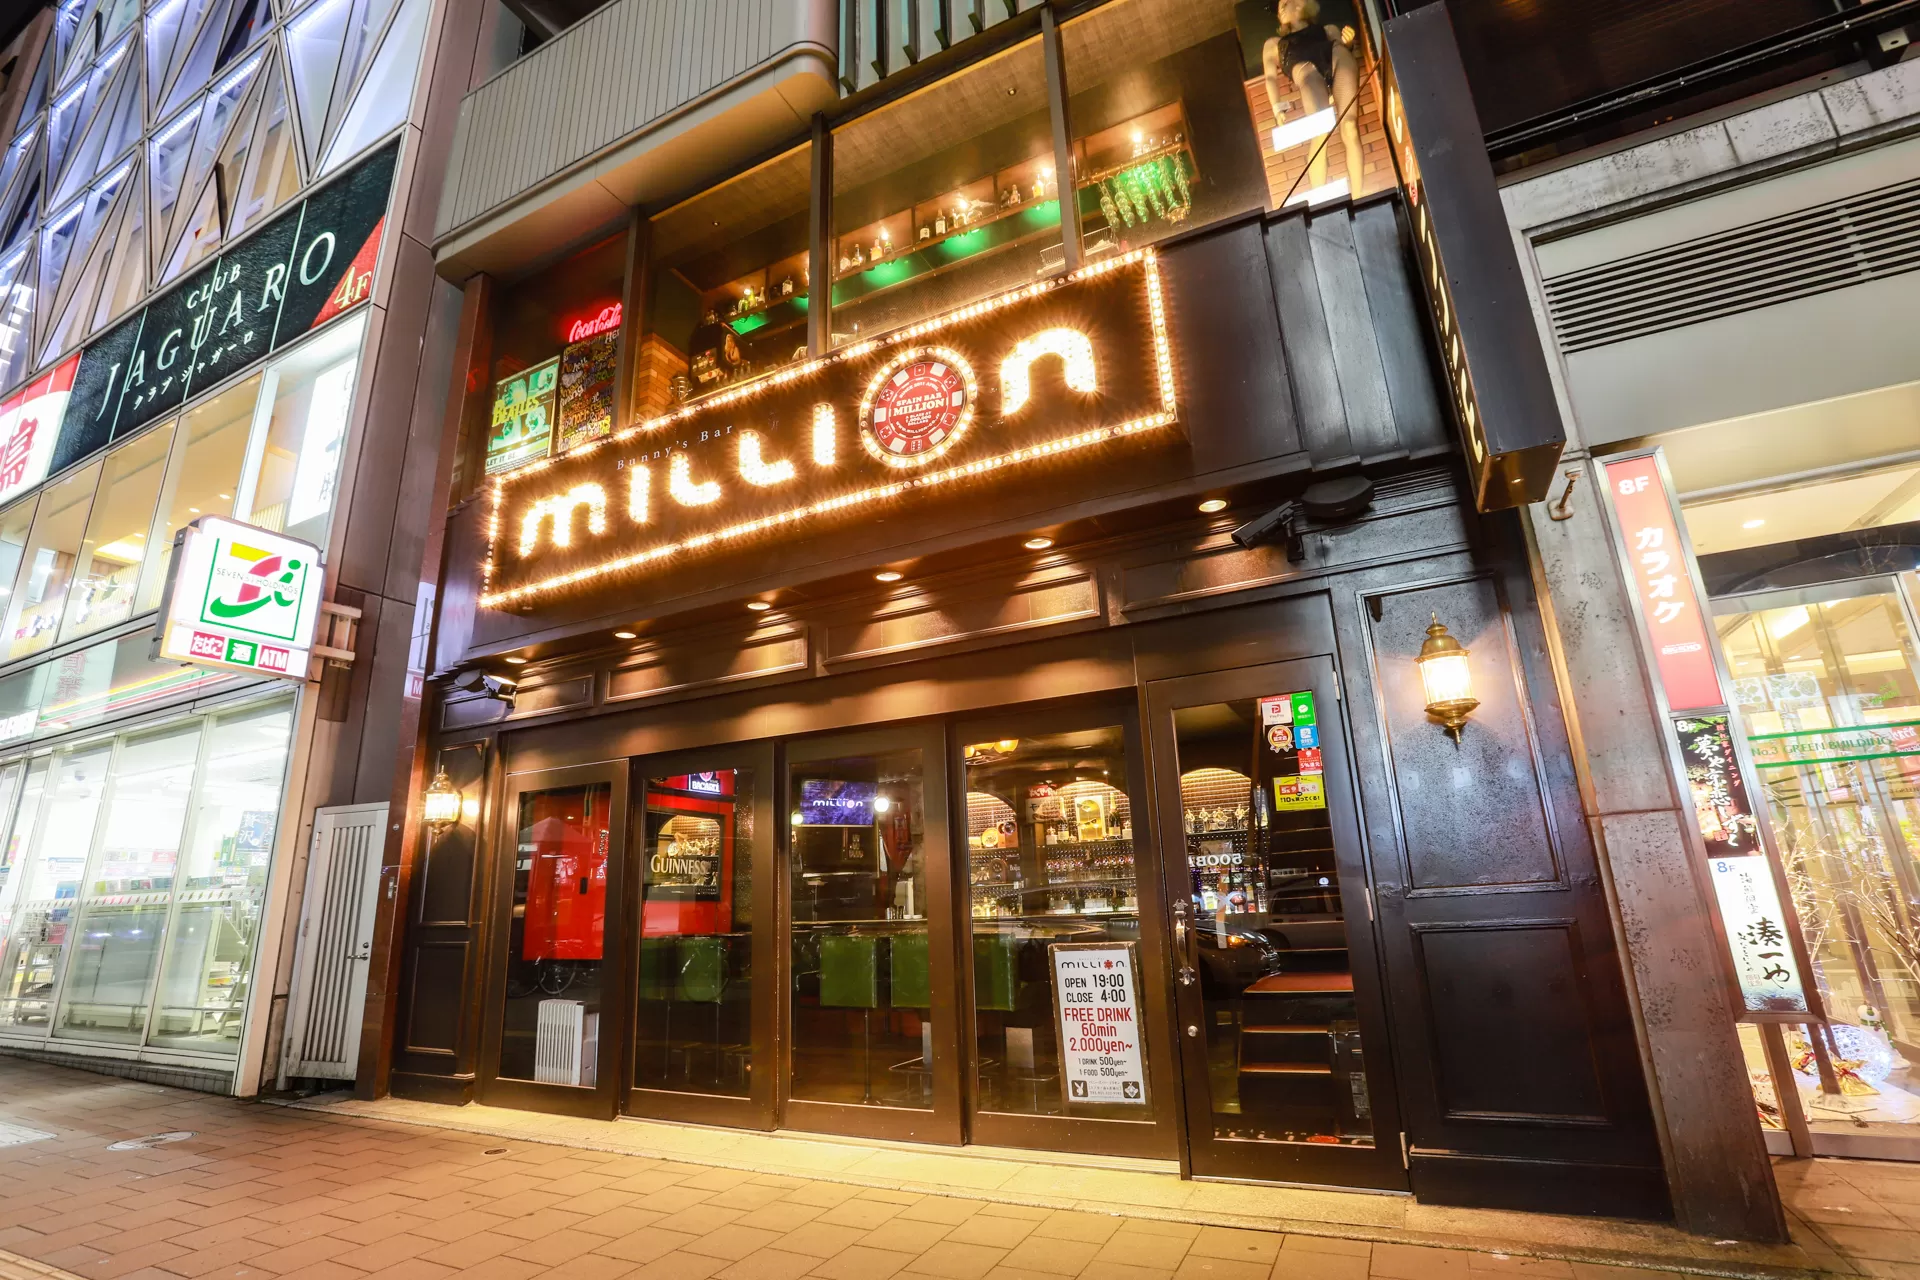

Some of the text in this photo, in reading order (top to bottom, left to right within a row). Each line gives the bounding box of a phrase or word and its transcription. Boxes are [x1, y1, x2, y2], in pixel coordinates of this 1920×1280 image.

[187, 264, 241, 309] CLUB
[334, 266, 371, 309] 4F
[96, 232, 336, 421] JAGUARO
[893, 398, 944, 416] MILLION
[896, 392, 942, 406] SPAIN BAR
[616, 424, 733, 470] Bunny's Bar
[1618, 475, 1650, 495] 8F
[216, 567, 244, 580] SEVEN
[257, 578, 298, 595] HOLDINGS
[1635, 527, 1685, 624] カラオケ
[191, 634, 289, 670] たばこ 酒 ATM
[1782, 743, 1826, 754] GREEN
[1829, 737, 1893, 750] BUILDING
[650, 854, 708, 875] GUINNESS
[1717, 861, 1736, 873] 8F
[1064, 974, 1125, 988] OPEN 19:00
[1066, 989, 1126, 1003] CLOSE 4:00
[1064, 1007, 1132, 1021] FREE DRINK
[1081, 1022, 1117, 1037] 60min
